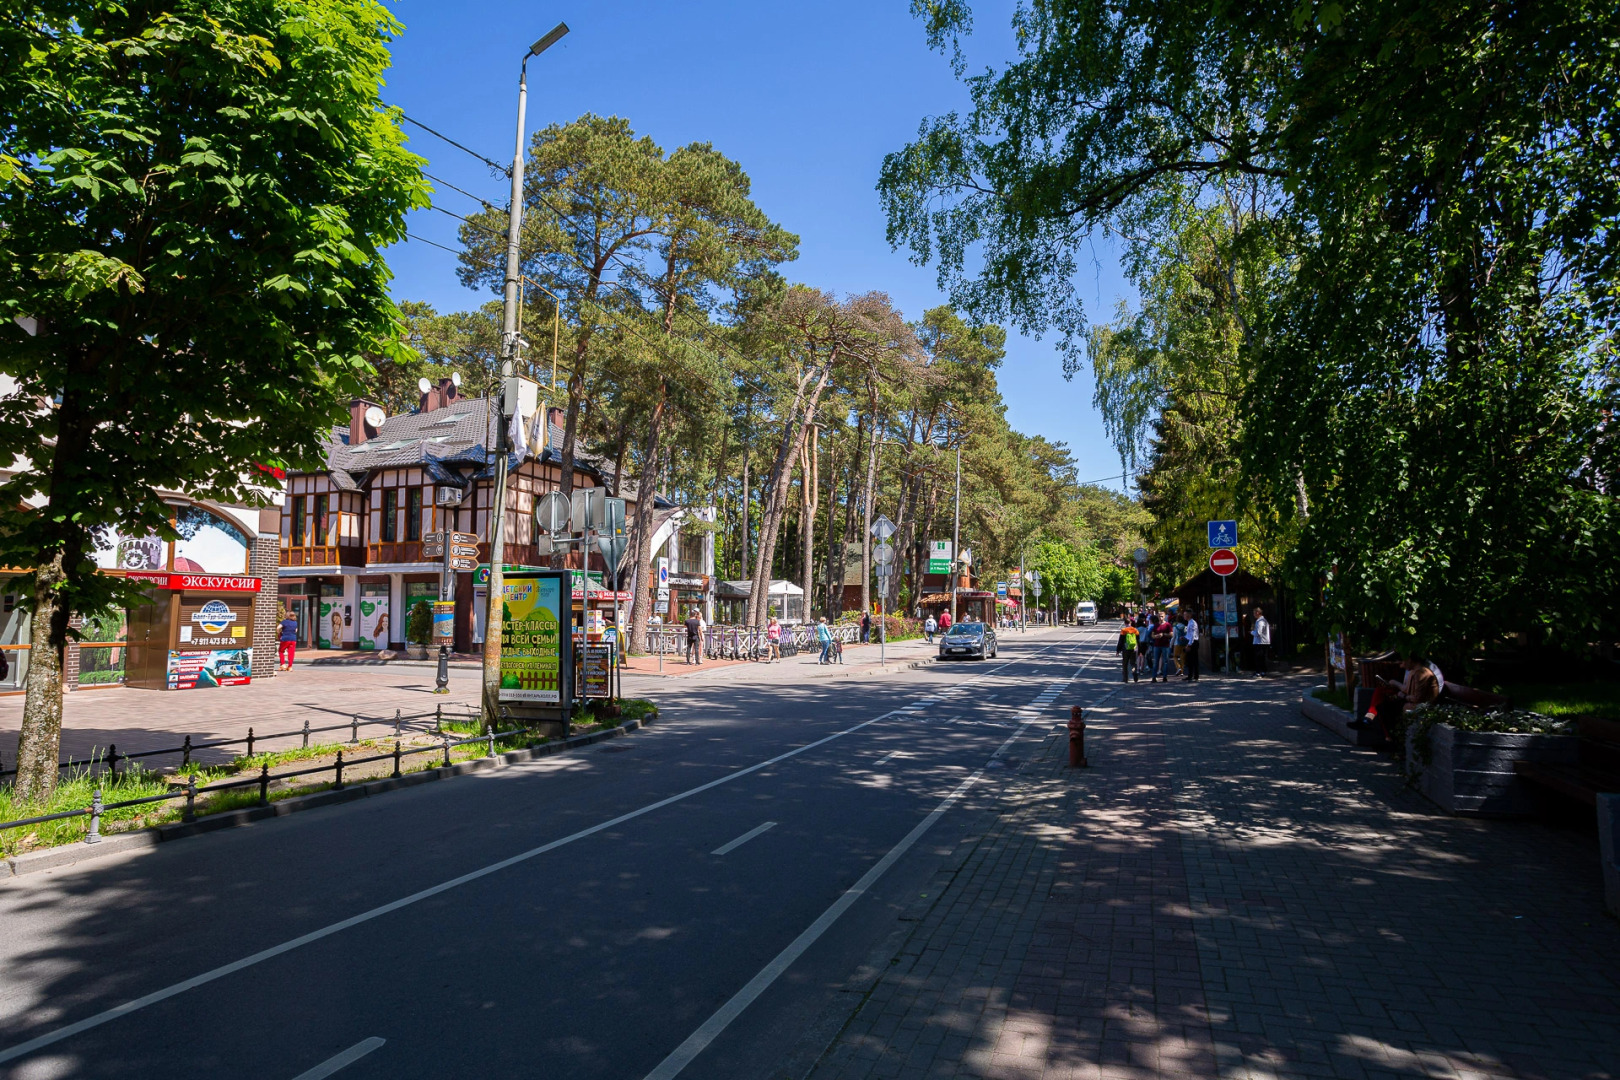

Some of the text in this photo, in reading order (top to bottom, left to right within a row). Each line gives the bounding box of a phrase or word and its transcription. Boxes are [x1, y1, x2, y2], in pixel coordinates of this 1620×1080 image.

[181, 575, 256, 589] ЭКСКУРСИИ
[504, 592, 528, 602] ЦЕНТР
[502, 621, 557, 631] АСТЕР-КЛАССЫ
[501, 632, 556, 644] ЛЯ ВСЕЙ СЕМЬИ
